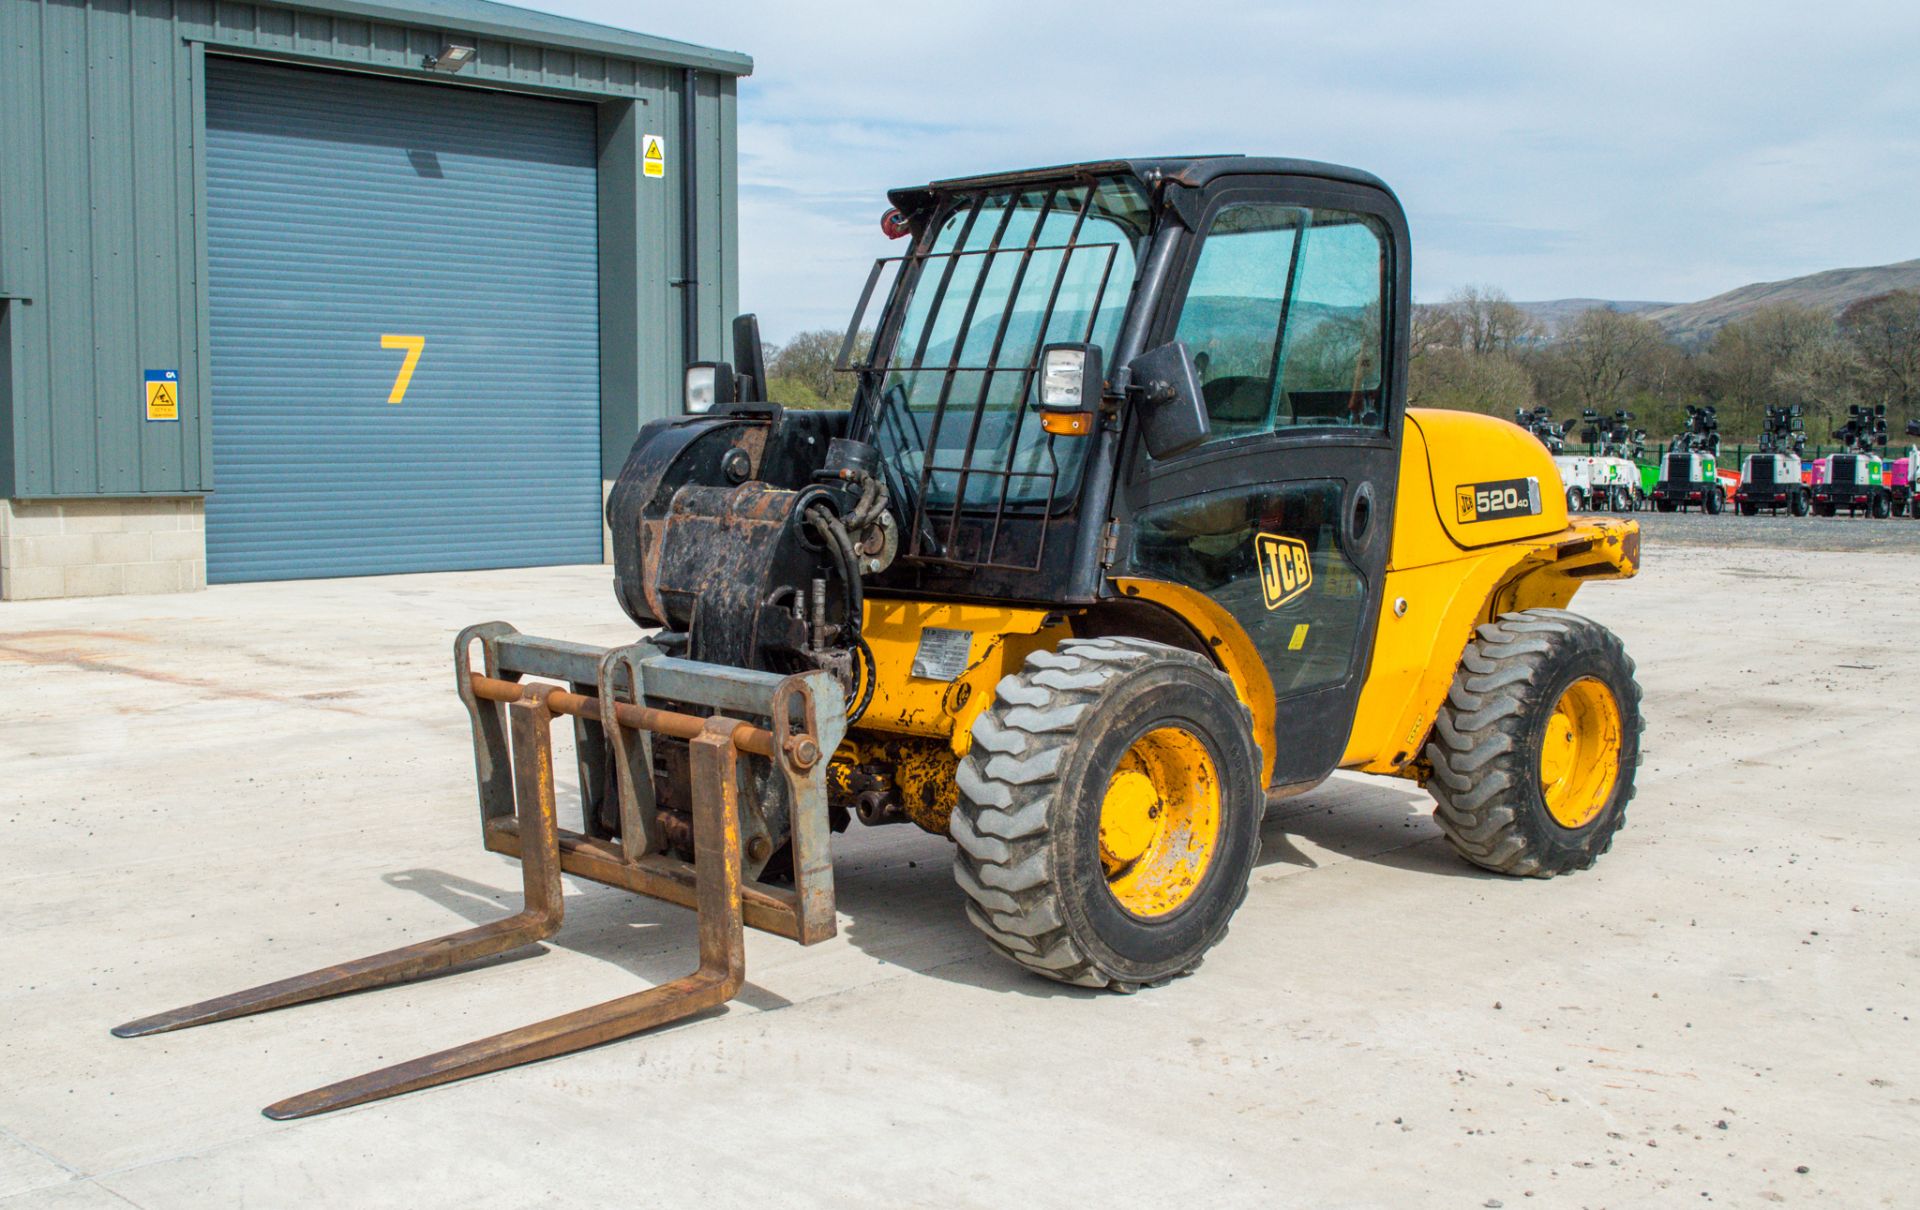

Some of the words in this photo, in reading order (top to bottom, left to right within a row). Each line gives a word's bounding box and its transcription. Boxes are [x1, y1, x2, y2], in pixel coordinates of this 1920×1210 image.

[381, 335, 425, 403] 7
[1461, 495, 1474, 513] JCB
[1476, 488, 1518, 513] 520
[1518, 499, 1529, 508] 40
[1264, 541, 1308, 601] JCB
